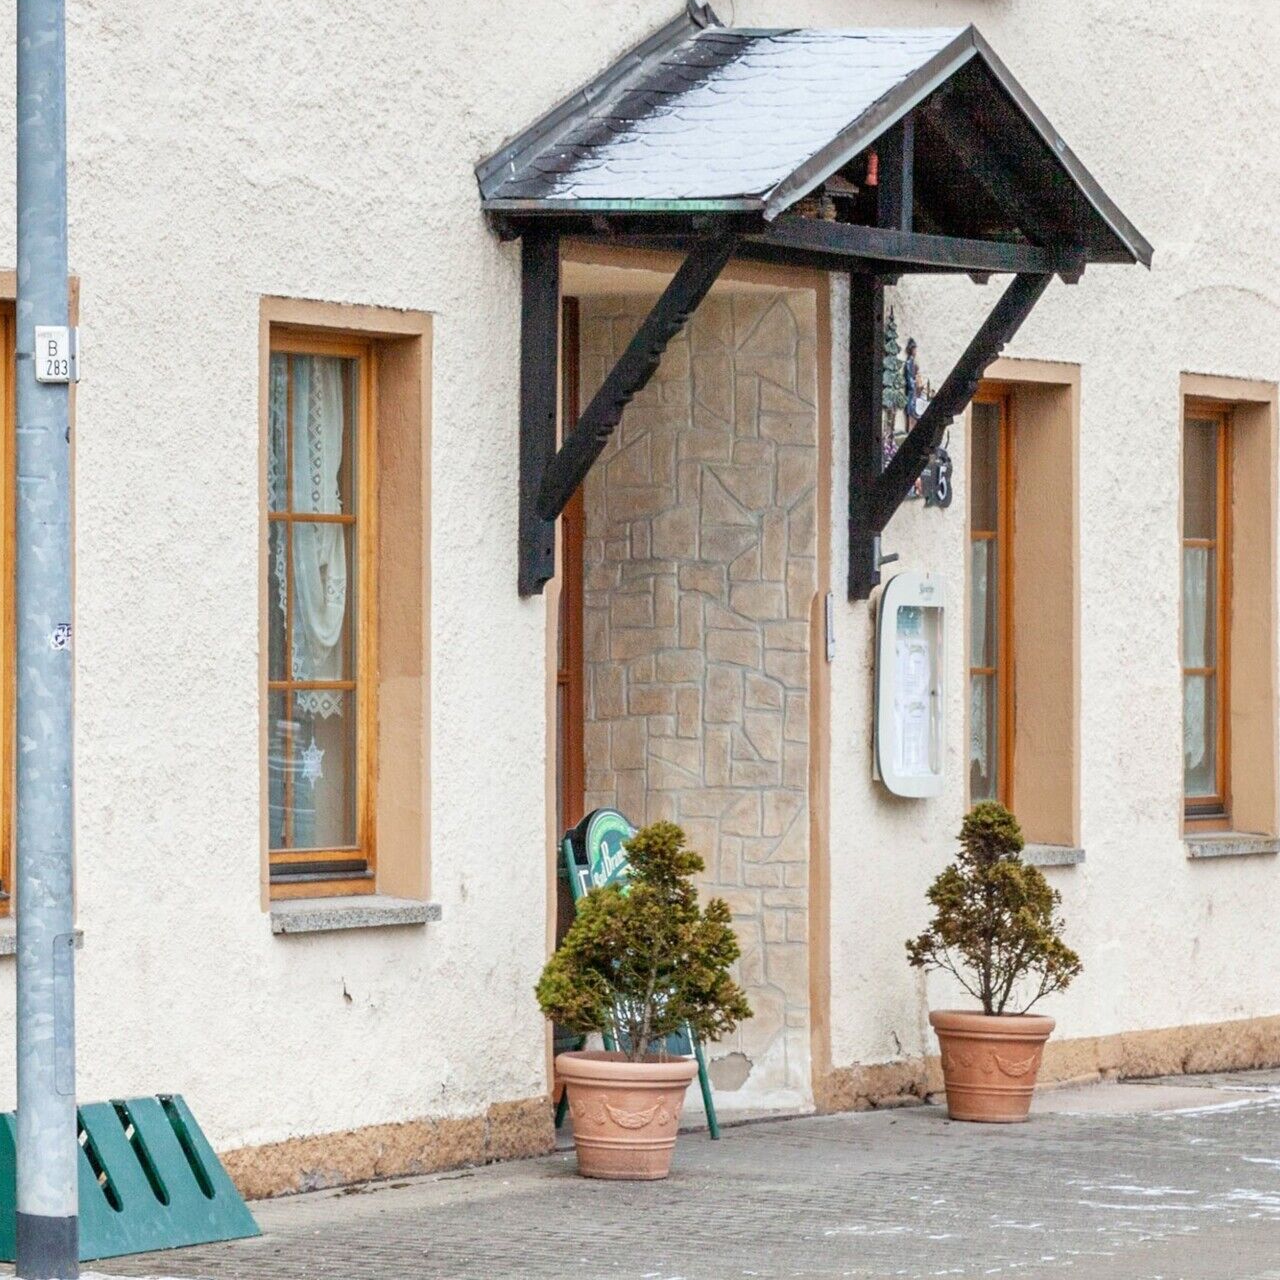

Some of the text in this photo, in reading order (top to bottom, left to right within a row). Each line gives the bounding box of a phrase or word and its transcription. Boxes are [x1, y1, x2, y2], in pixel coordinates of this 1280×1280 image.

[48, 340, 58, 357] B
[46, 359, 68, 376] 283
[938, 465, 948, 500] 5
